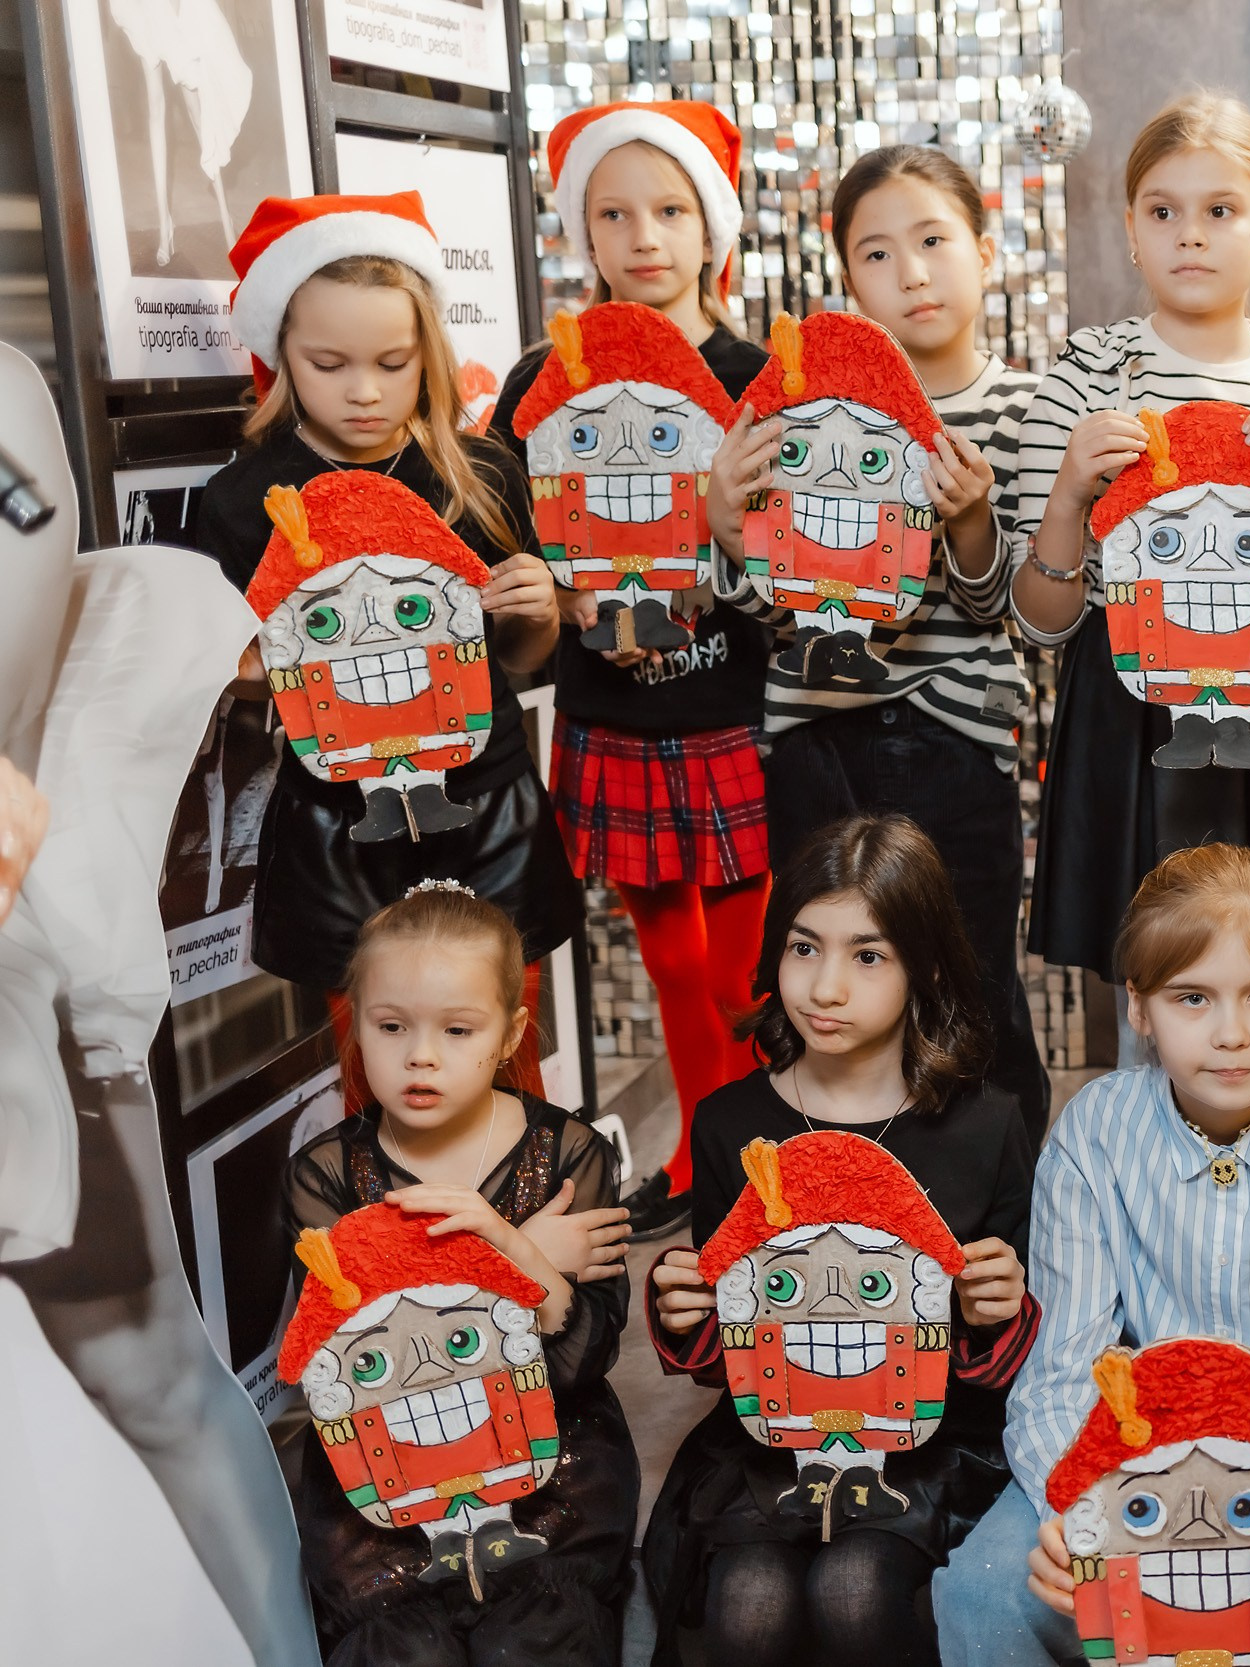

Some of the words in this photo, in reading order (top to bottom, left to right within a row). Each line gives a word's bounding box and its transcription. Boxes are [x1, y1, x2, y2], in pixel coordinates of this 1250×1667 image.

[442, 248, 494, 274] аться,
[135, 297, 162, 314] Ваша
[165, 299, 219, 319] креативная
[176, 925, 241, 957] типография
[170, 944, 239, 985] m_pechati
